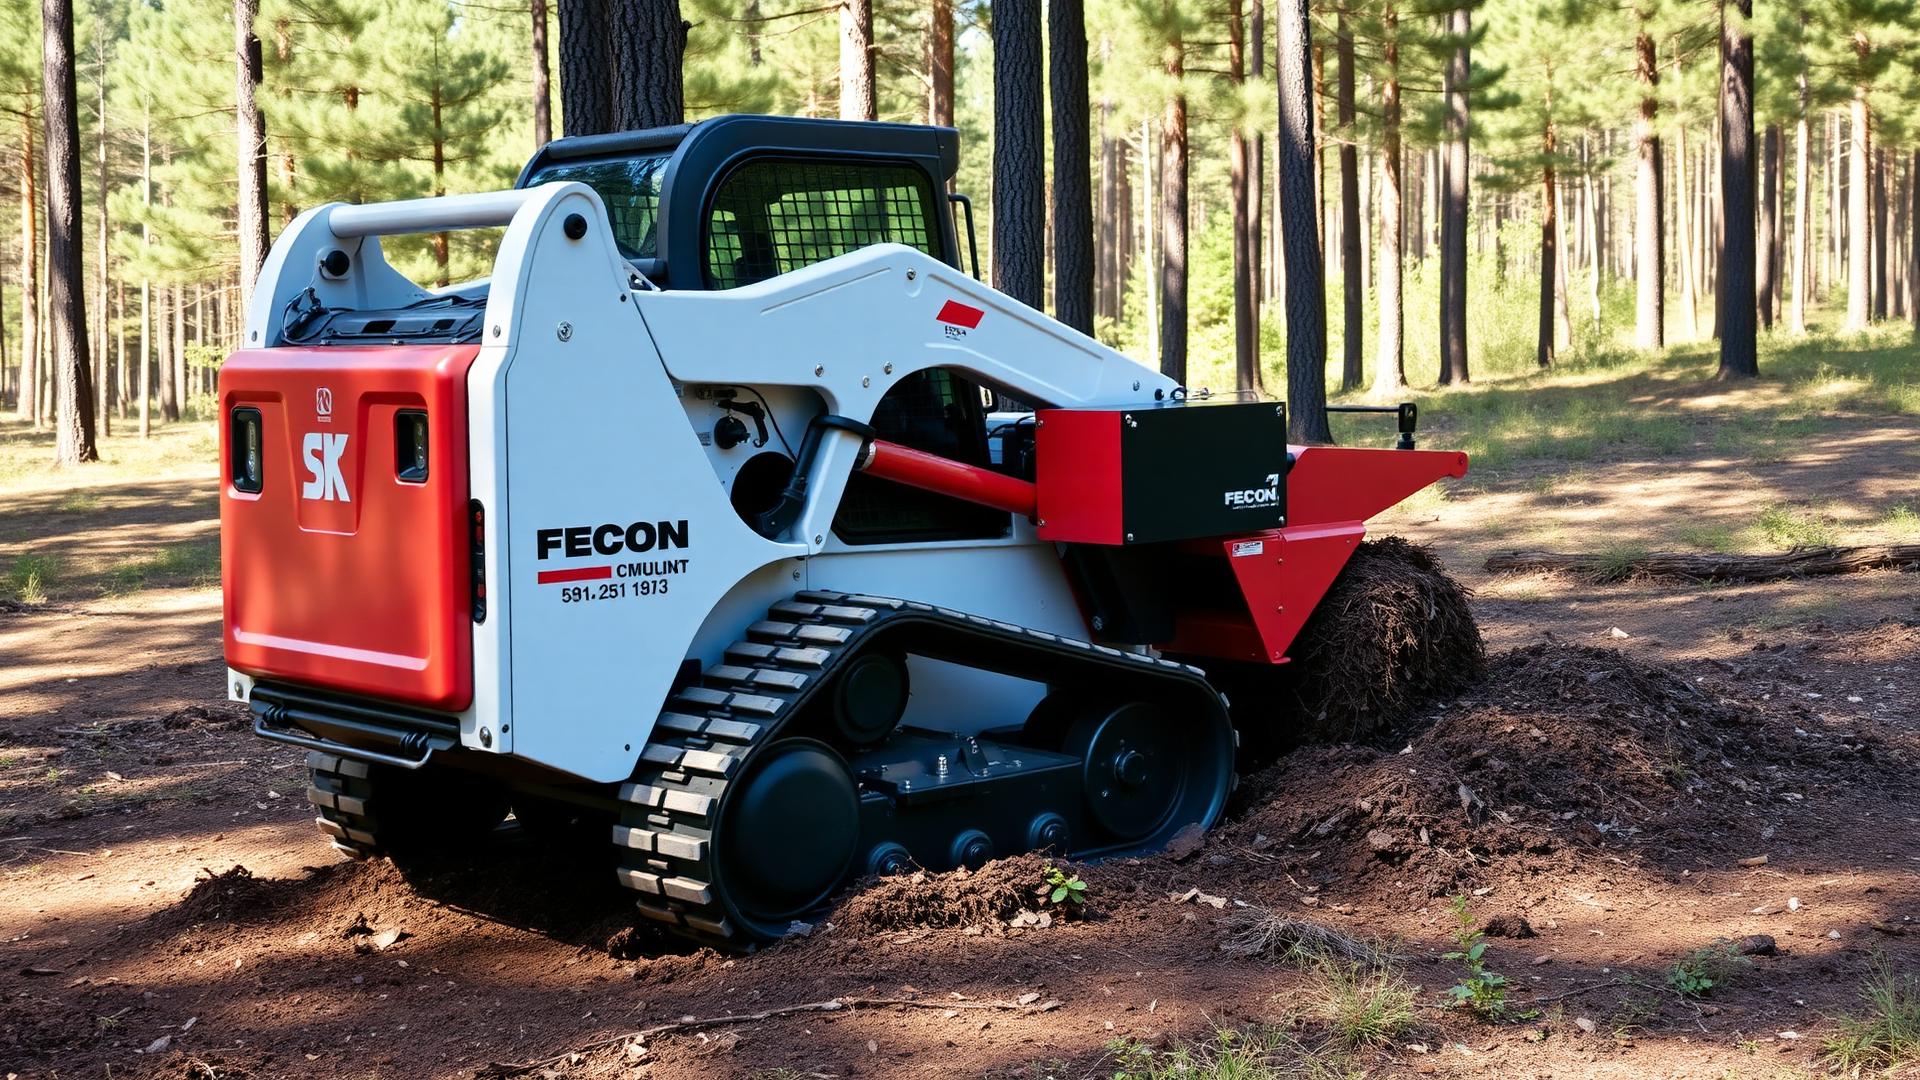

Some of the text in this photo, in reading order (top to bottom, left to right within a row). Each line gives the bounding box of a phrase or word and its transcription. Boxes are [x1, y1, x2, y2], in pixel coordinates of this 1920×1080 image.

[302, 432, 351, 502] SK
[1224, 486, 1277, 505] FECON
[537, 519, 689, 560] FECON
